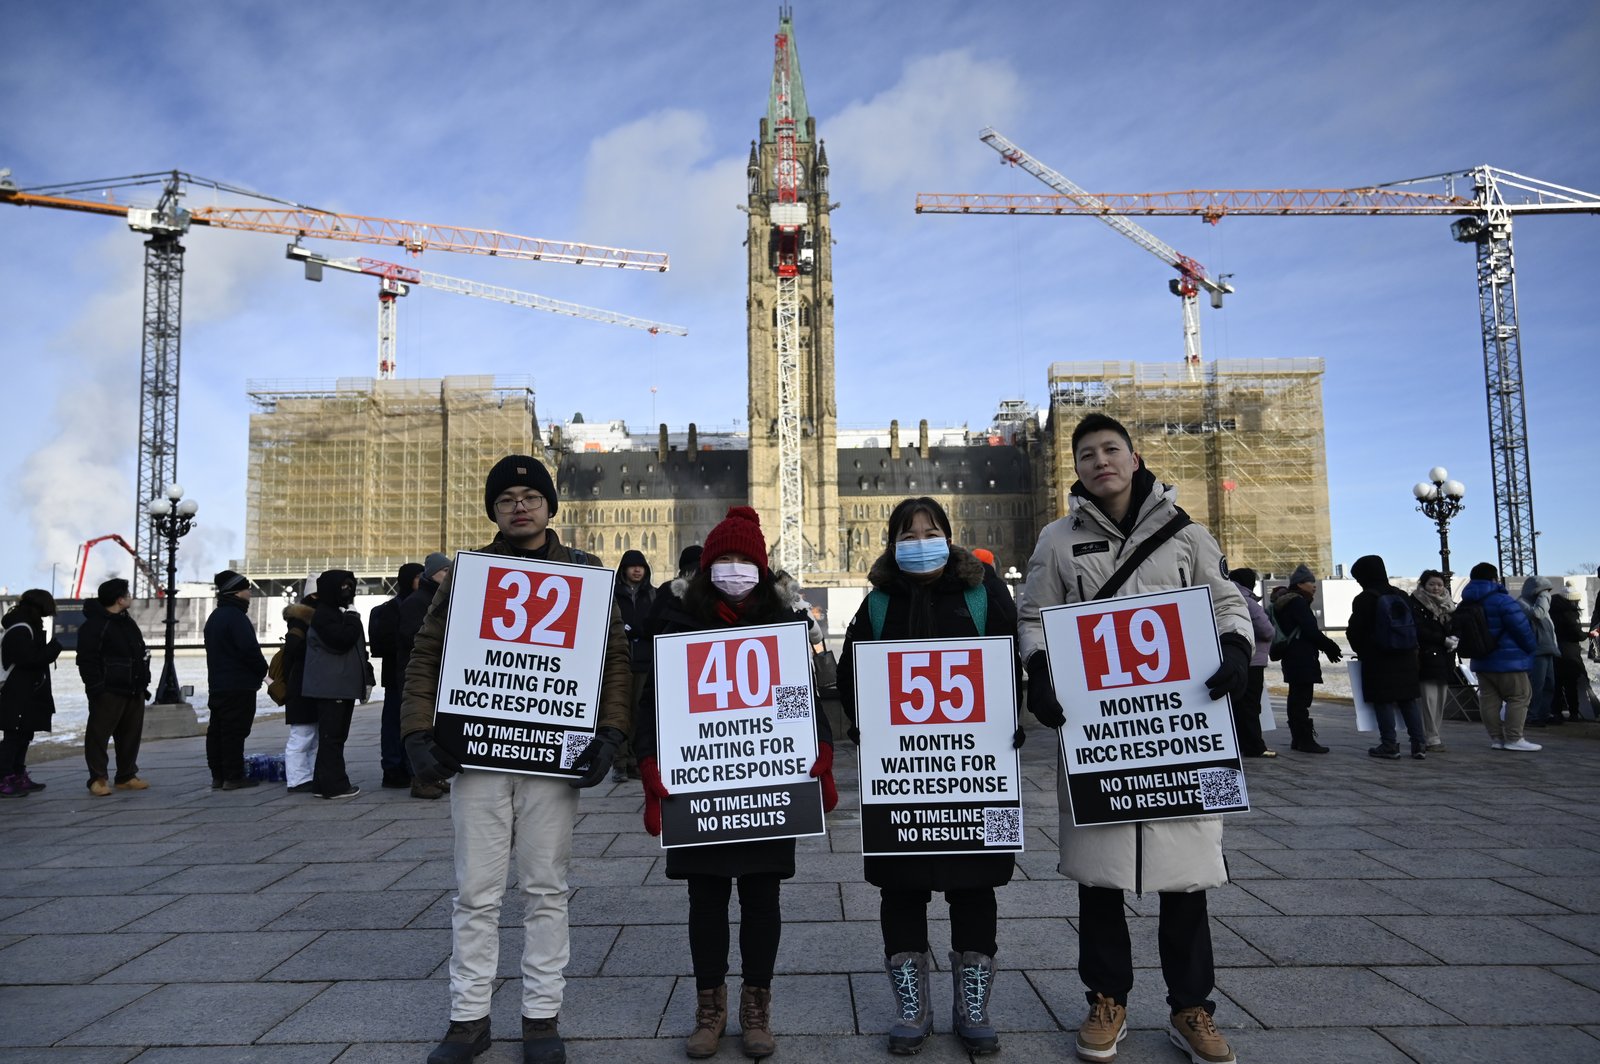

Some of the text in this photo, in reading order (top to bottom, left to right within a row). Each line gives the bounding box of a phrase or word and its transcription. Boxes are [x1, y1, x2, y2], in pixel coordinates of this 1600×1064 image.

[491, 570, 571, 646] 32
[1092, 608, 1171, 688] 19
[484, 649, 562, 673] MONTHS
[463, 668, 579, 696] WAITING FOR
[697, 638, 771, 709] 40
[900, 651, 974, 723] 55
[449, 689, 587, 719] IRCC RESPONSE
[1100, 692, 1183, 717] MONTHS
[463, 722, 564, 746] NO TIMELINES
[699, 717, 773, 739] MONTHS
[1083, 712, 1209, 742] WAITING FOR
[467, 741, 555, 762] NO RESULTS
[680, 737, 795, 762] WAITING FOR
[900, 733, 975, 752] MONTHS
[1076, 733, 1225, 765] IRCC RESPONSE
[671, 757, 807, 785] IRCC RESPONSE
[881, 755, 996, 774] WAITING FOR
[872, 776, 1008, 795] IRCC RESPONSE
[1100, 771, 1198, 793] NO TIMELINE
[690, 791, 791, 814] NO TIMELINES
[1110, 790, 1204, 810] NO RESULTS
[698, 810, 786, 832] NO RESULTS
[891, 810, 911, 824] NO
[898, 826, 984, 842] NO RESULTS
